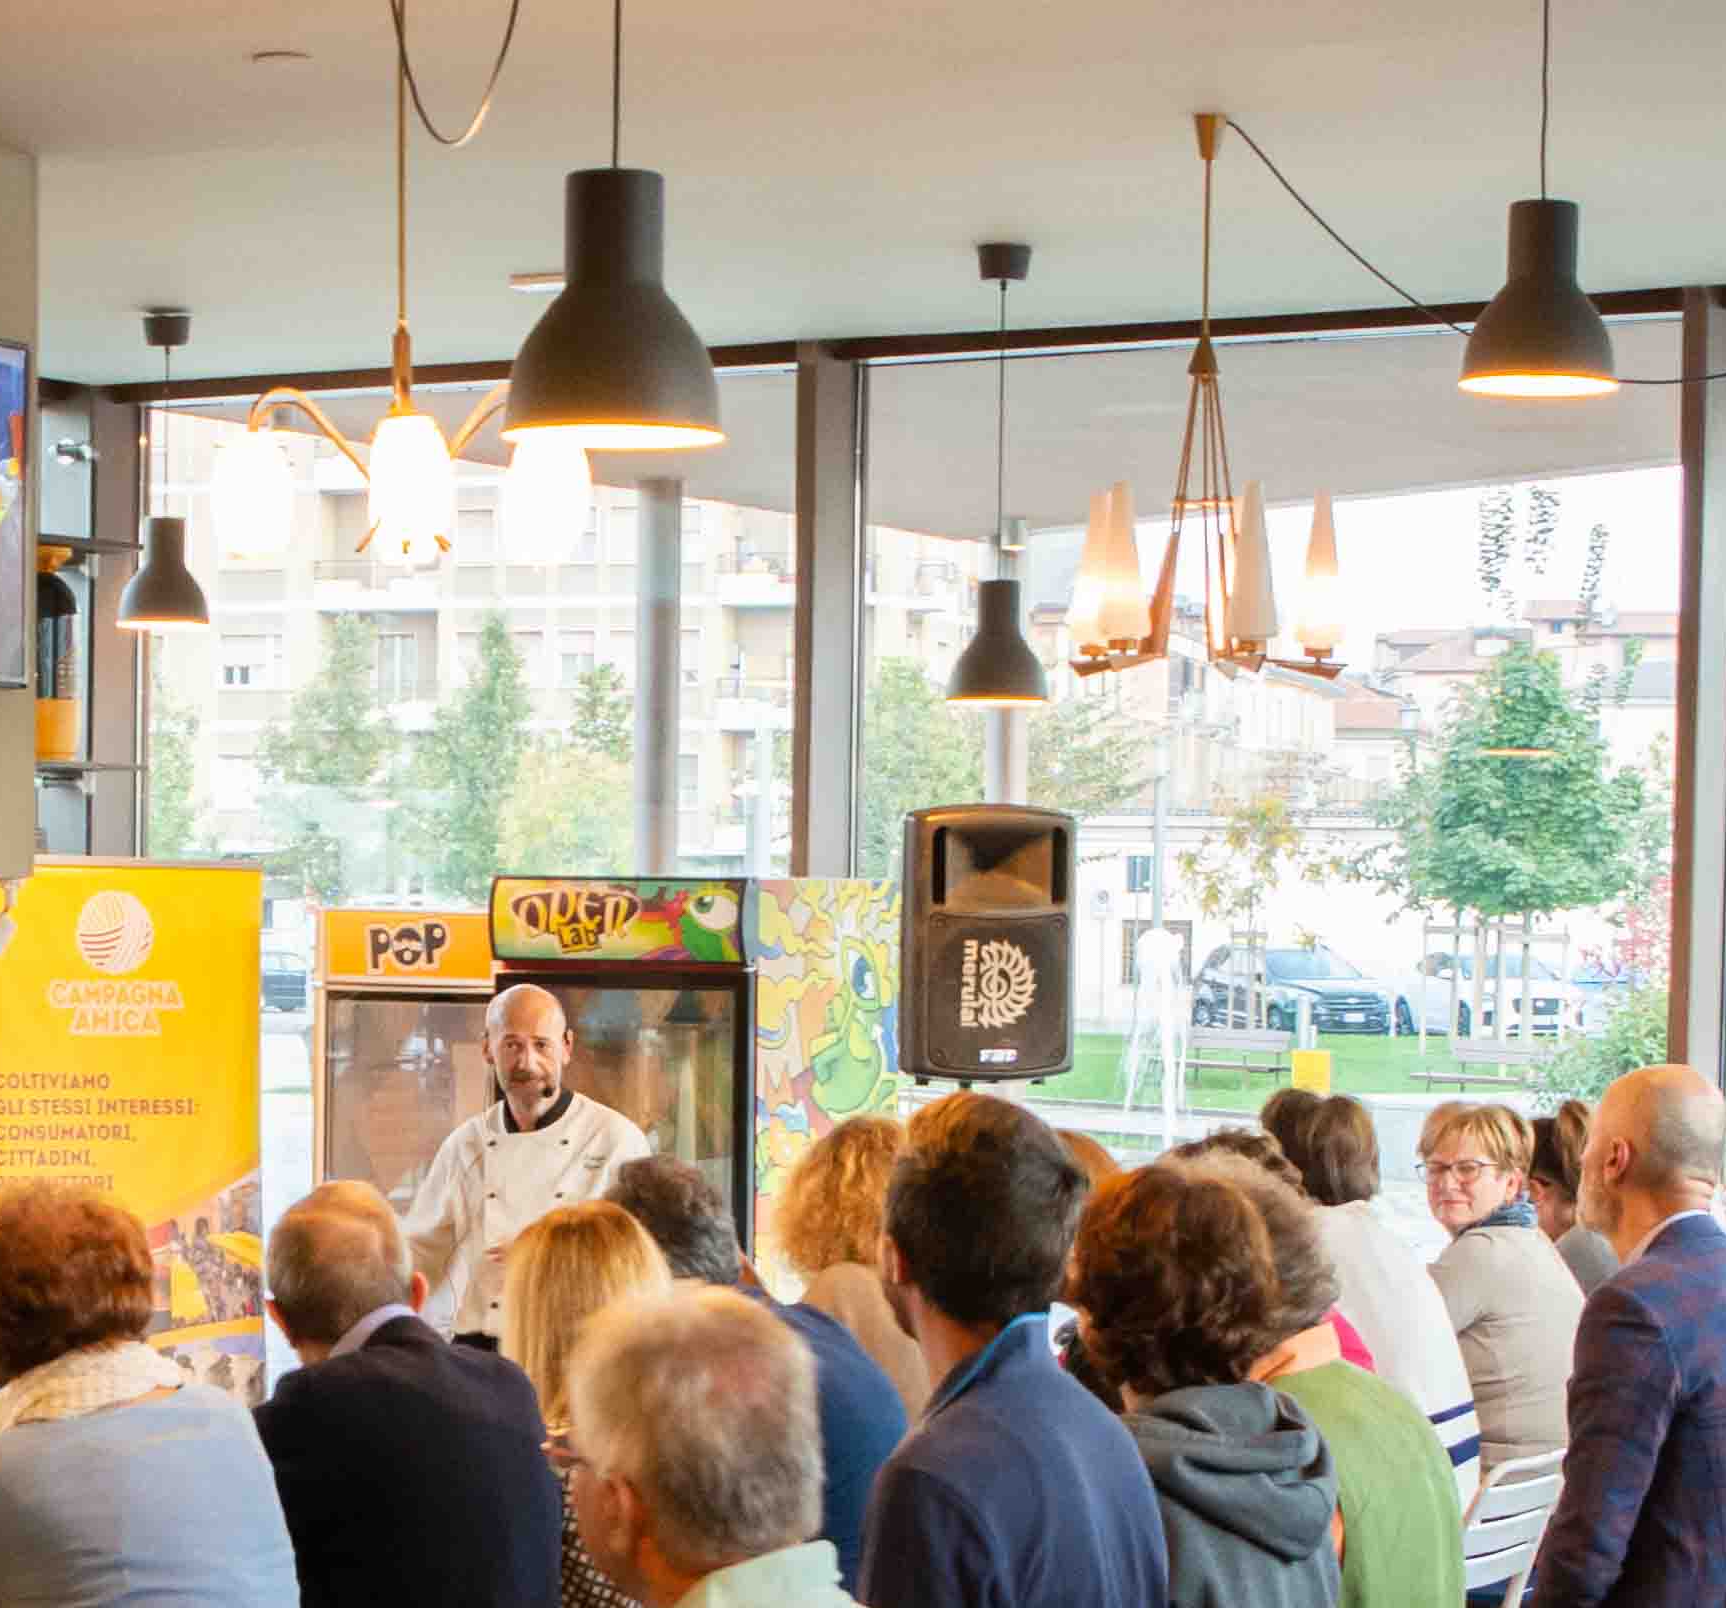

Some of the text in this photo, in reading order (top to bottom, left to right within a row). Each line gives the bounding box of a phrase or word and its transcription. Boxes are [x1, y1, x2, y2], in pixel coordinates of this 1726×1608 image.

[368, 922, 448, 969] POP
[50, 982, 181, 1007] CAMPAGNA
[74, 1008, 158, 1032] AMICA
[29, 1099, 92, 1116] STESSI
